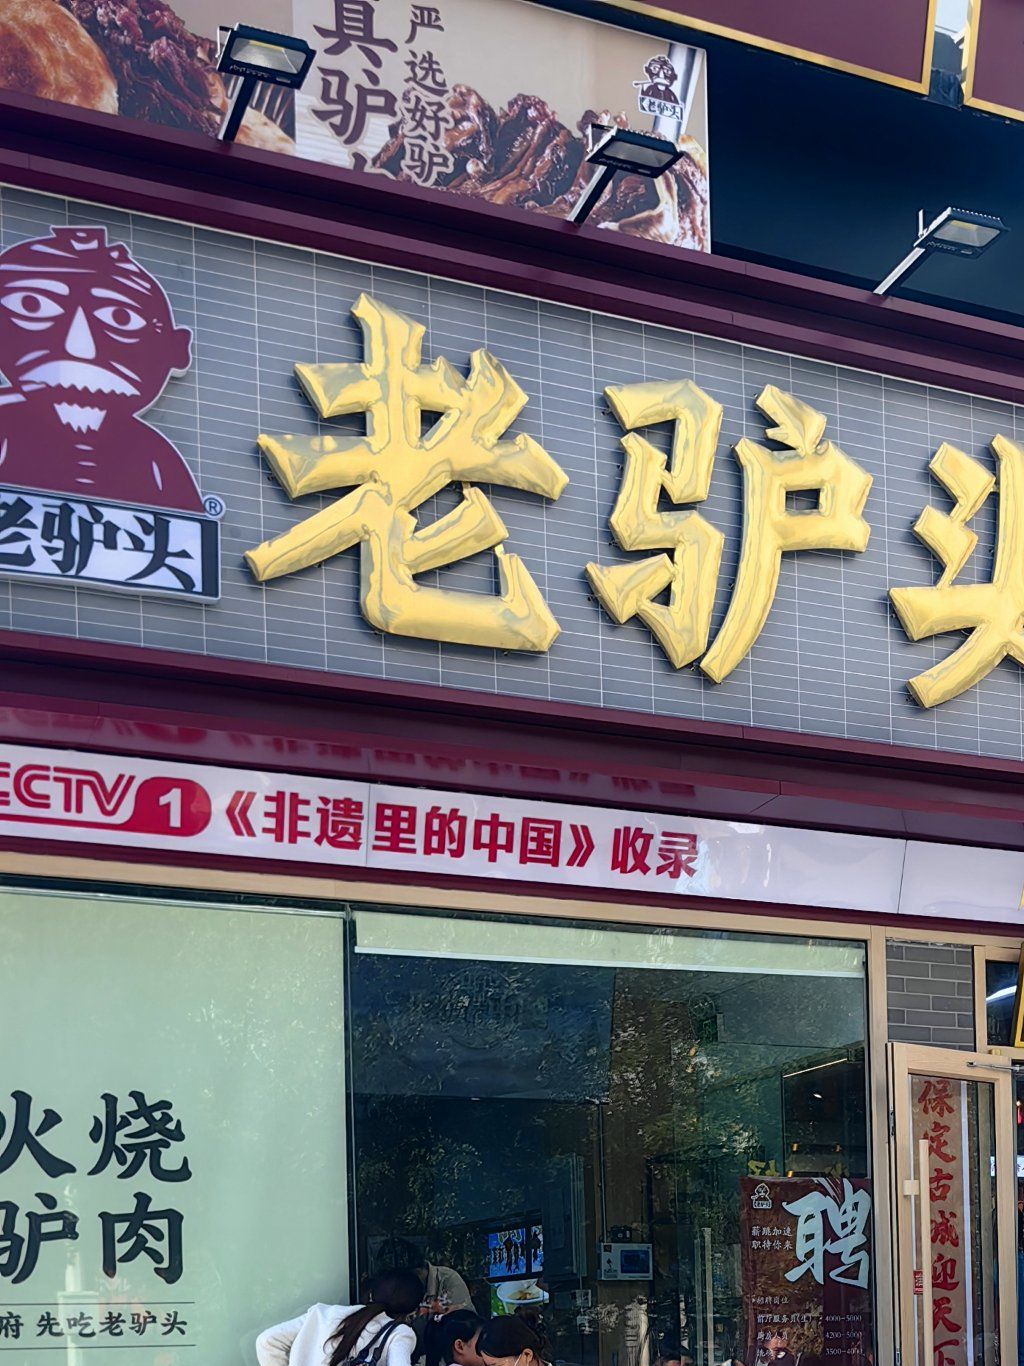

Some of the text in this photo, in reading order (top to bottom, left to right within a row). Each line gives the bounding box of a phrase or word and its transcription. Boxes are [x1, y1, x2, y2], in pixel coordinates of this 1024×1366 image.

[405, 4, 450, 184] 严选好驴
[0, 1090, 192, 1182] 火烧
[782, 1178, 871, 1289] 聘
[36, 1311, 188, 1337] 先吃老驴头
